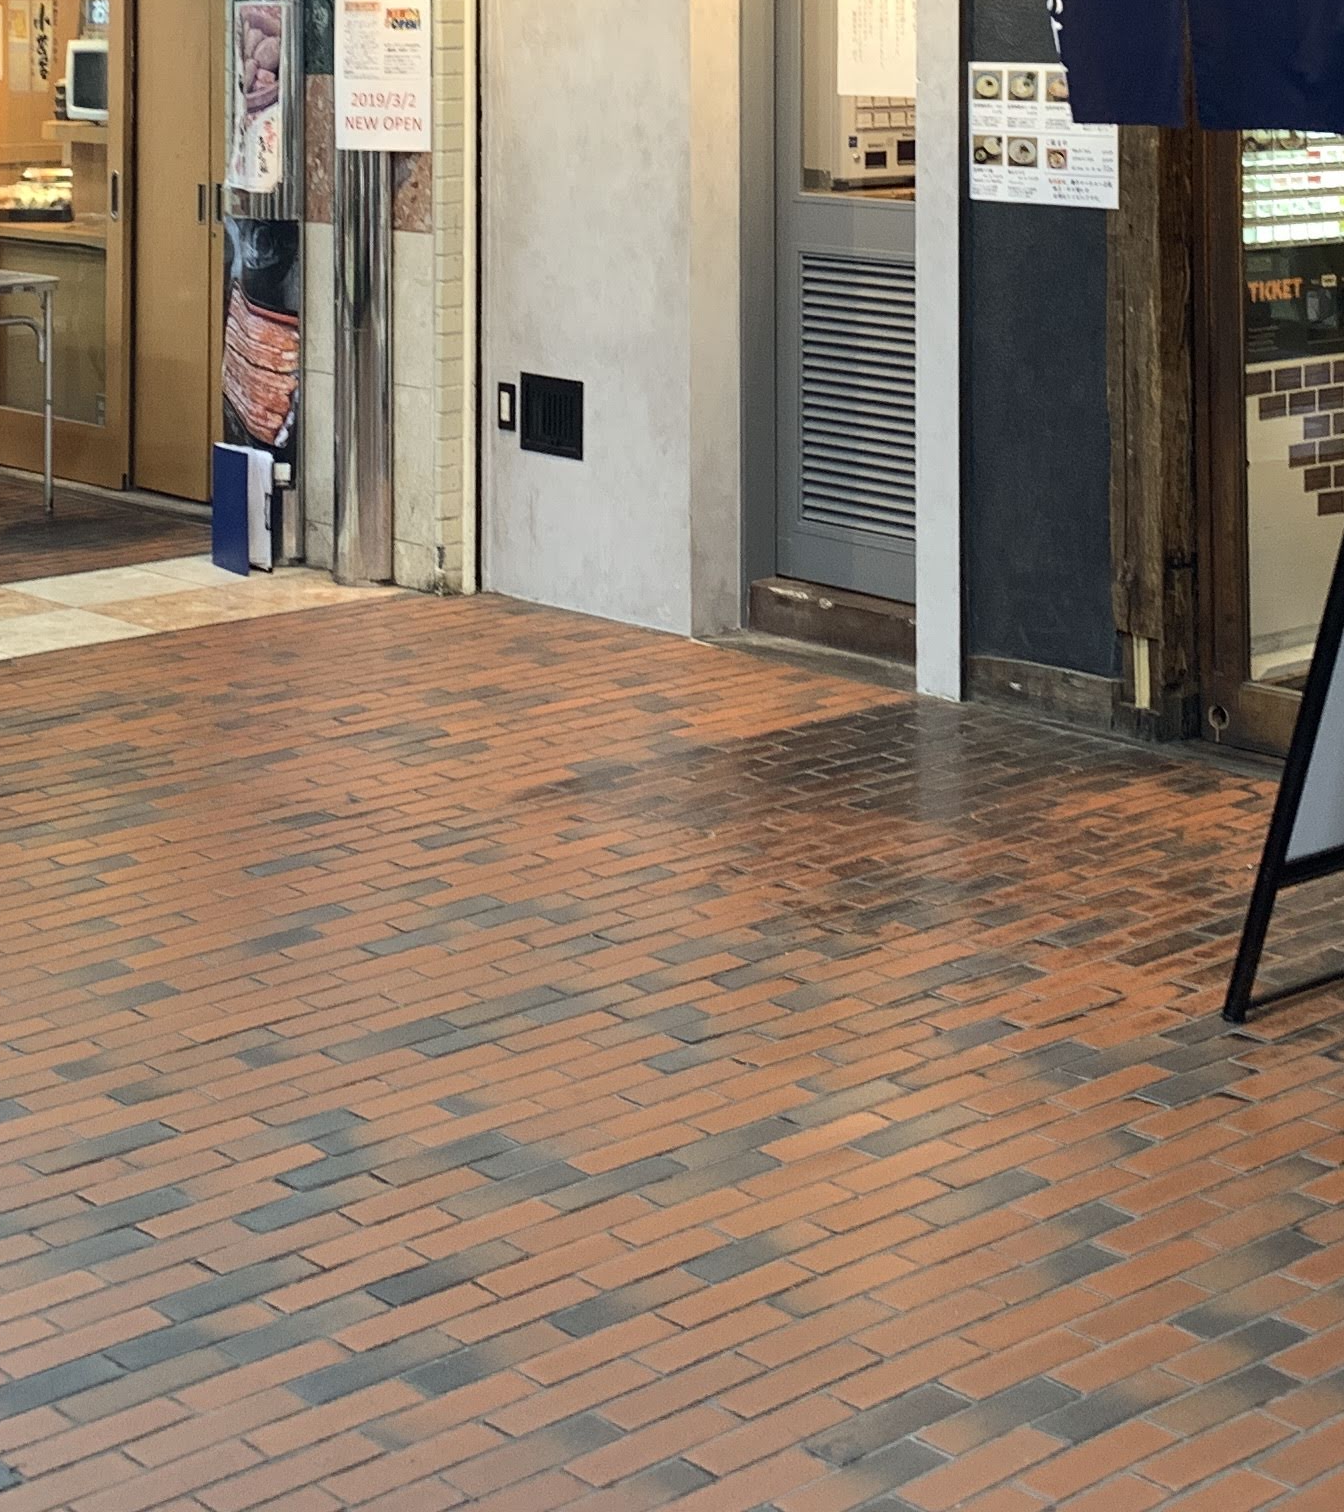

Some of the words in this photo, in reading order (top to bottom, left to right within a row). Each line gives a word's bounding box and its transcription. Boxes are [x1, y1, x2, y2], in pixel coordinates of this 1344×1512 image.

[350, 92, 417, 110] 2019/3/2
[344, 115, 380, 132] NEW
[383, 115, 423, 133] OPEN
[1244, 275, 1304, 303] TICKET
